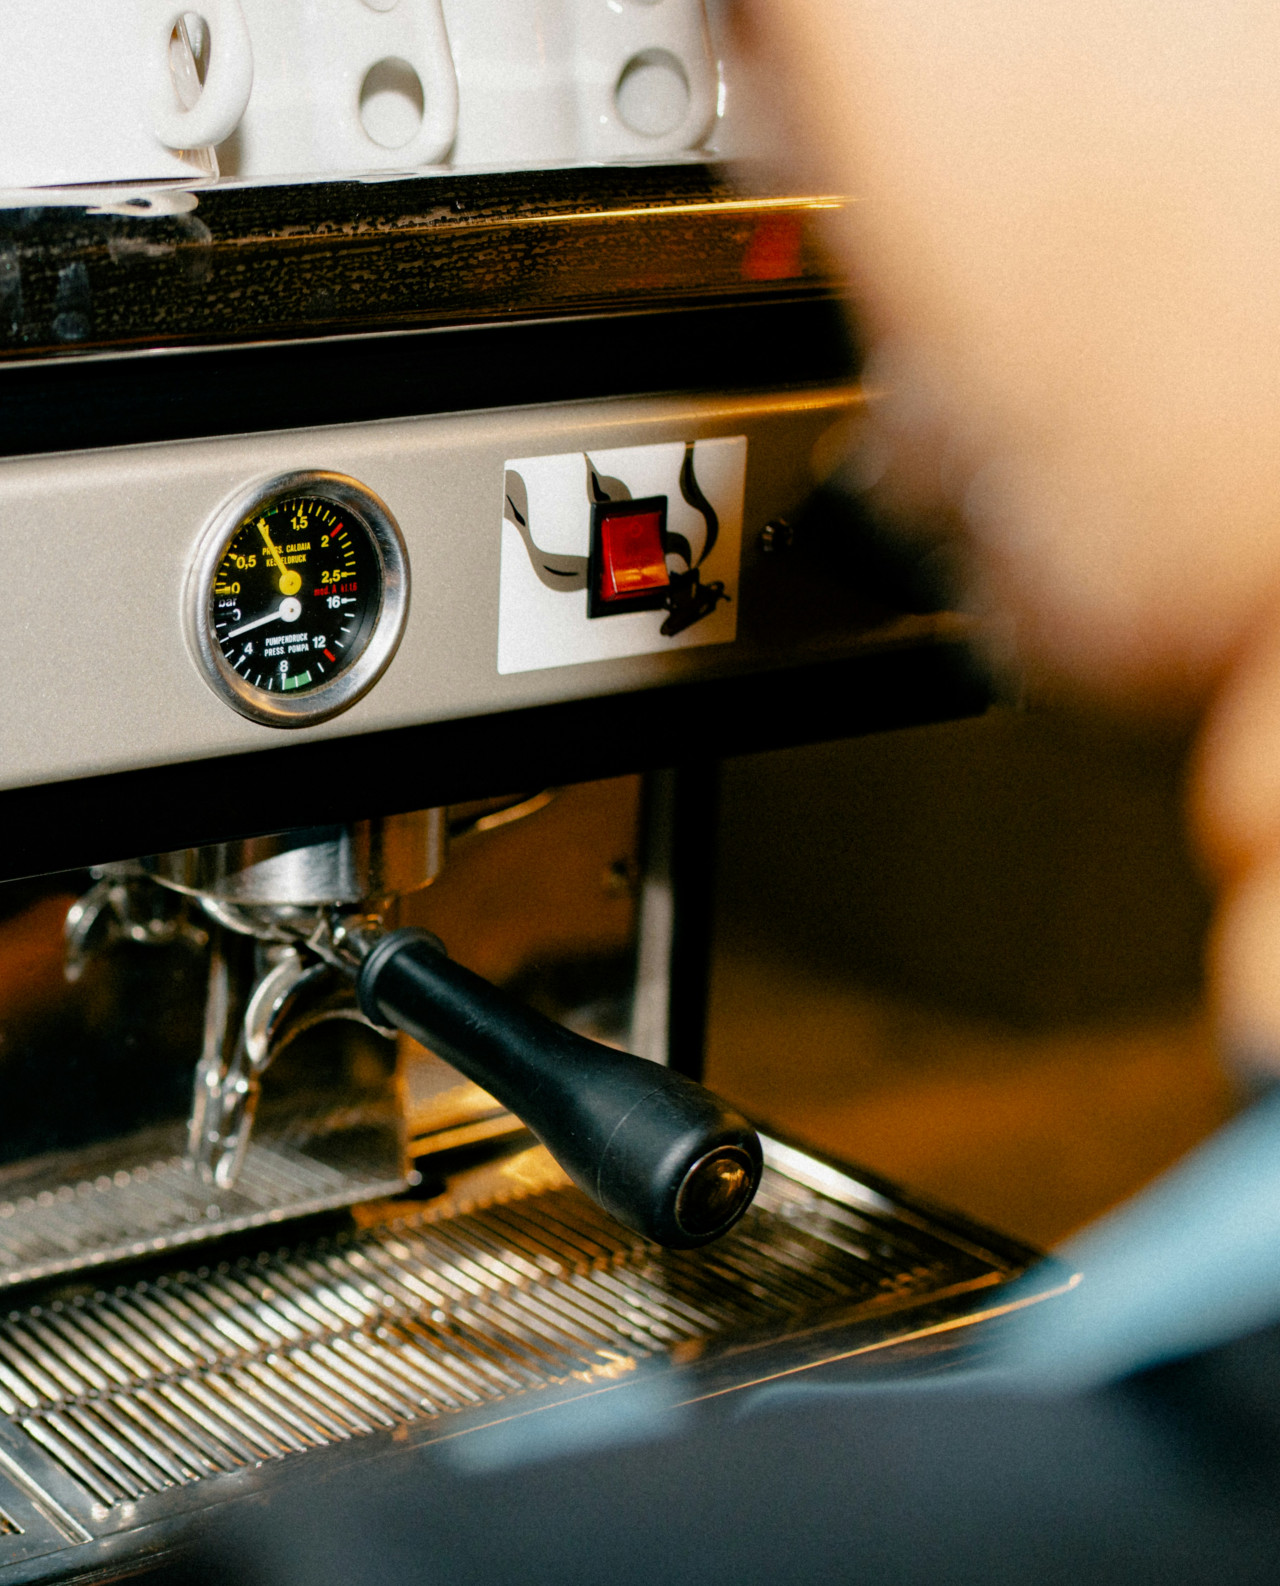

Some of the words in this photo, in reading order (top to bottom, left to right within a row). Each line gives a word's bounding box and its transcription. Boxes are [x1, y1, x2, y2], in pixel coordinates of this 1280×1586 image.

[291, 516, 308, 531] 1,5
[286, 542, 311, 553] CALDAIA
[321, 535, 330, 548] 2
[236, 555, 257, 570] 0,5
[321, 569, 341, 584] 2,5
[231, 582, 241, 594] 0
[331, 583, 337, 594] A
[218, 597, 238, 608] bar
[326, 595, 341, 609] 16
[265, 632, 308, 647] PUMPENDRUCK
[312, 635, 326, 649] 12
[243, 642, 254, 655] 4
[264, 646, 286, 657] PRESS.
[287, 643, 310, 654] POMPA
[279, 660, 289, 673] 8
